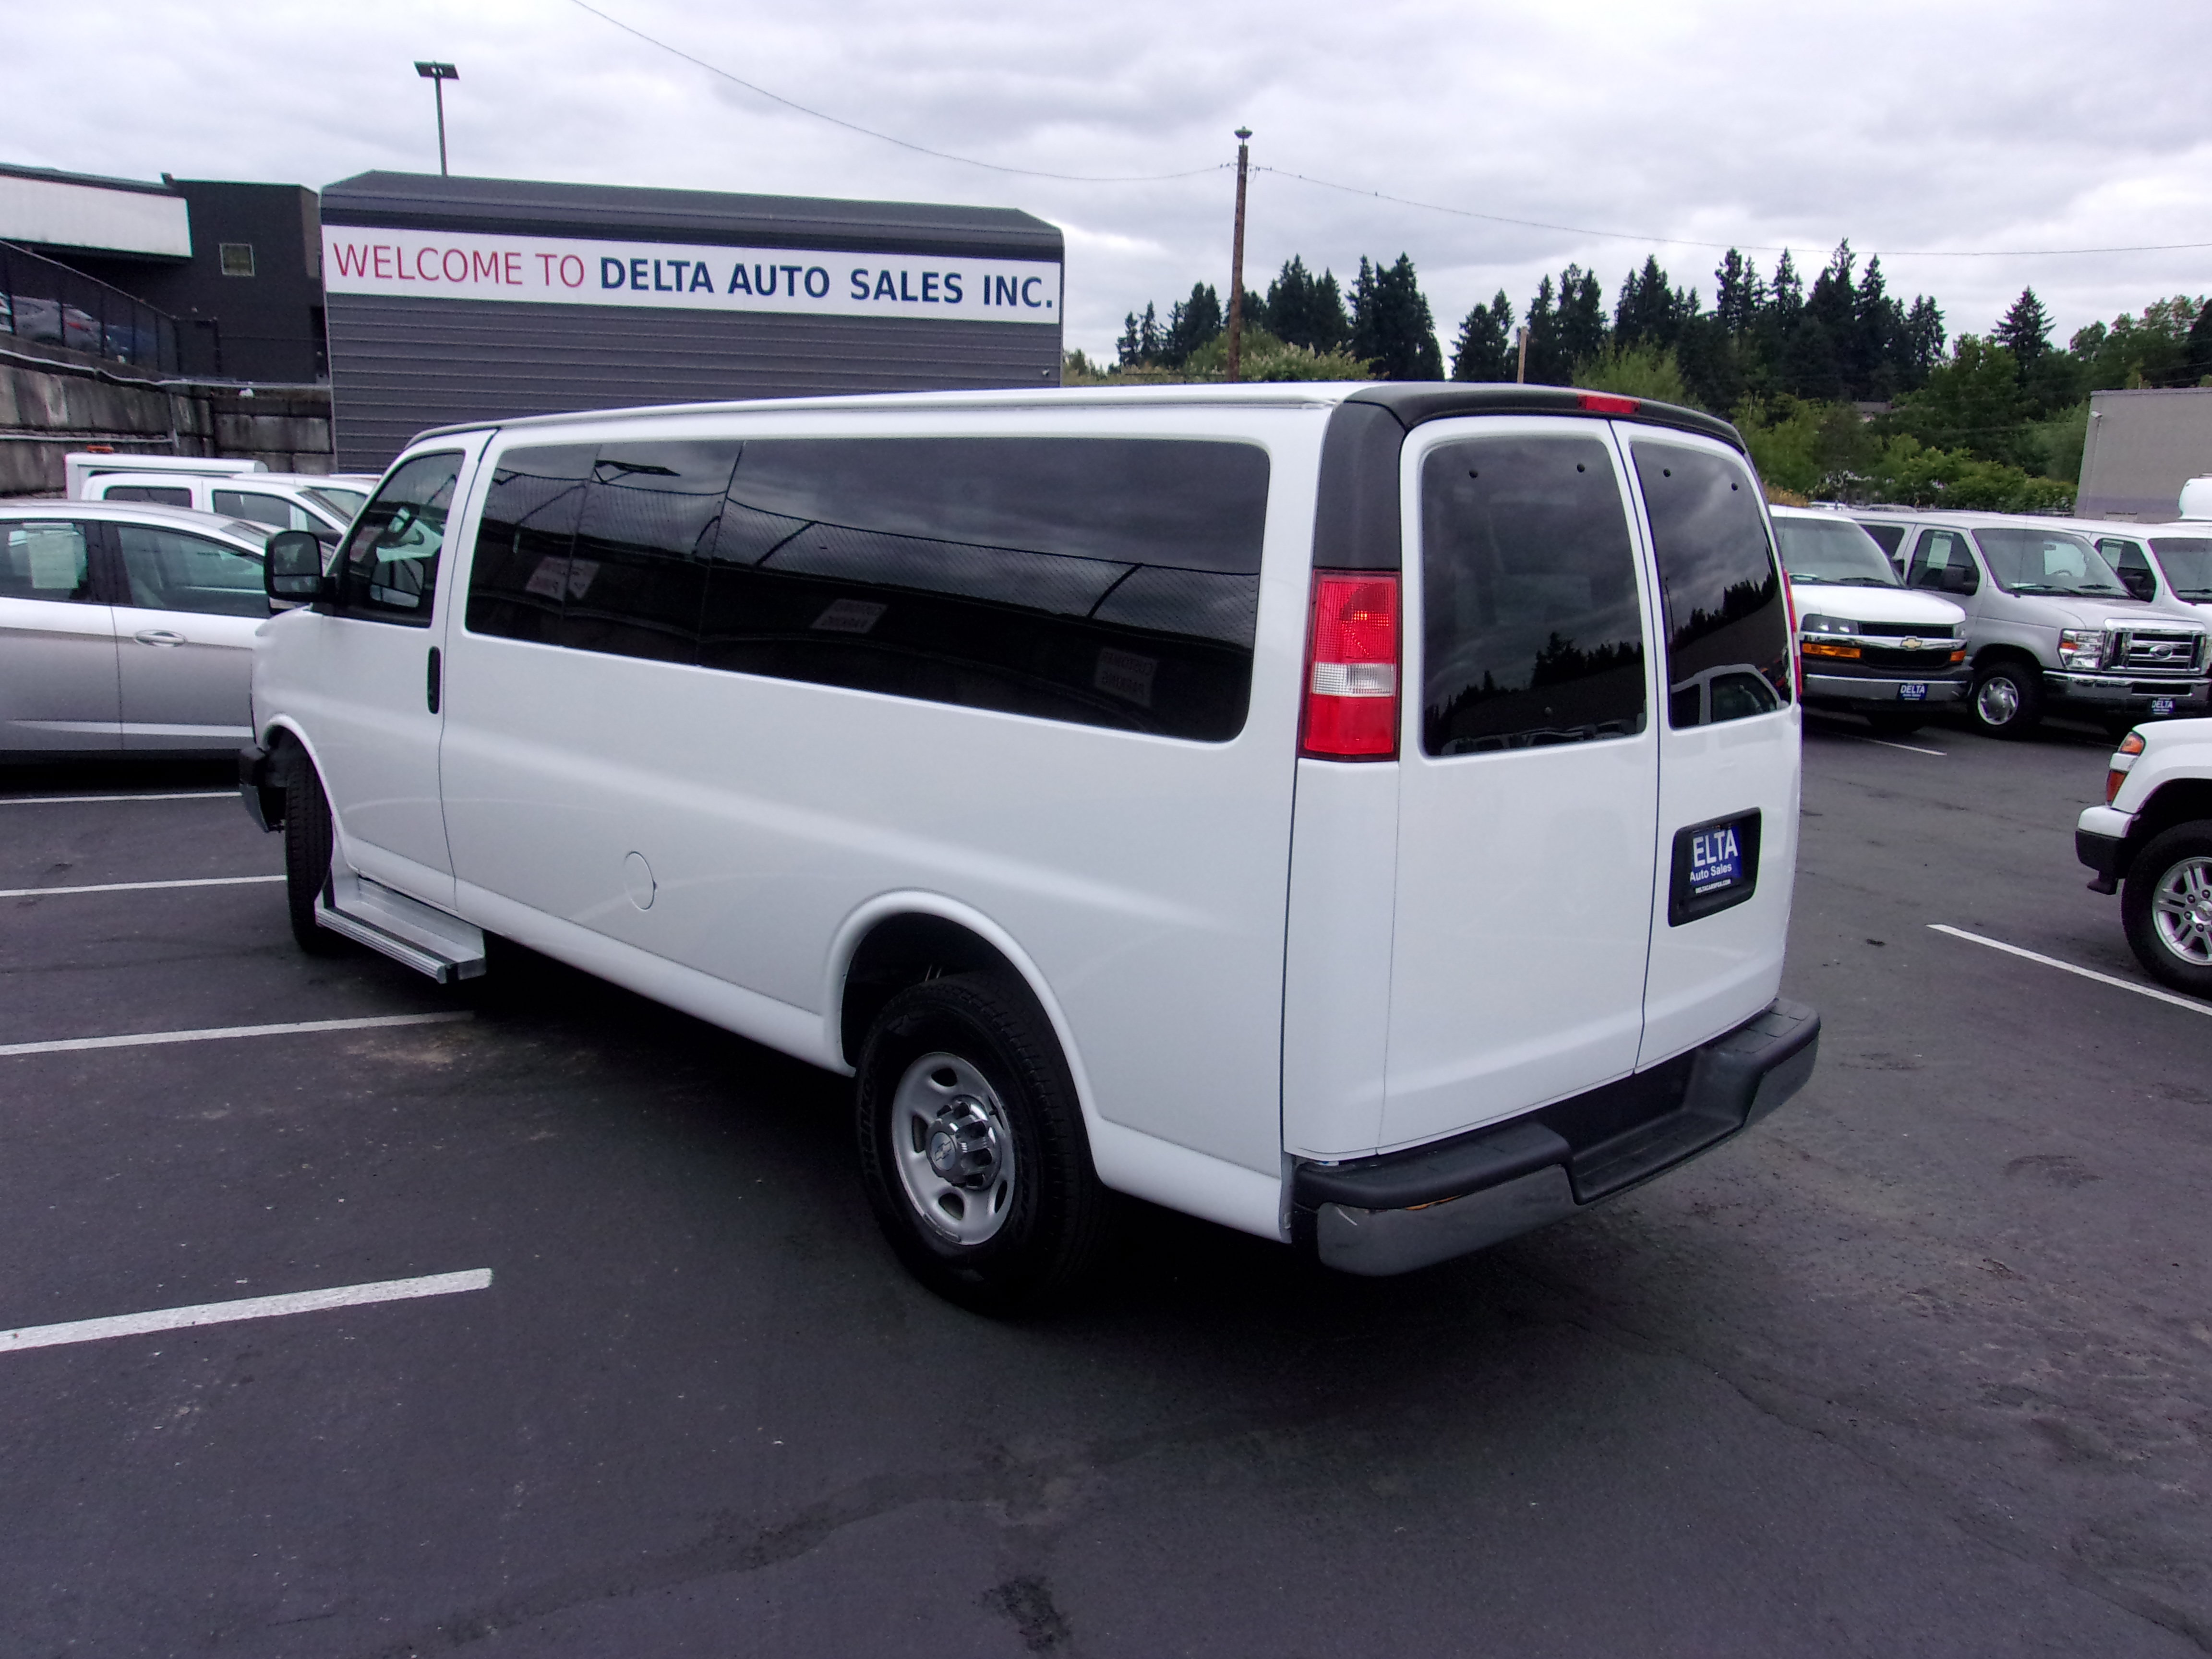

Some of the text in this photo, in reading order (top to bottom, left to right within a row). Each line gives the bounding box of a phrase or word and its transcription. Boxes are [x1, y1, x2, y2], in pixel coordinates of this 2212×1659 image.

[333, 242, 1053, 308] WELCOME TO DELTA AUTO SALES INC.
[1900, 685, 1925, 694] DELTA
[2152, 700, 2173, 709] DELTA
[1689, 863, 1732, 882] Auto Sales
